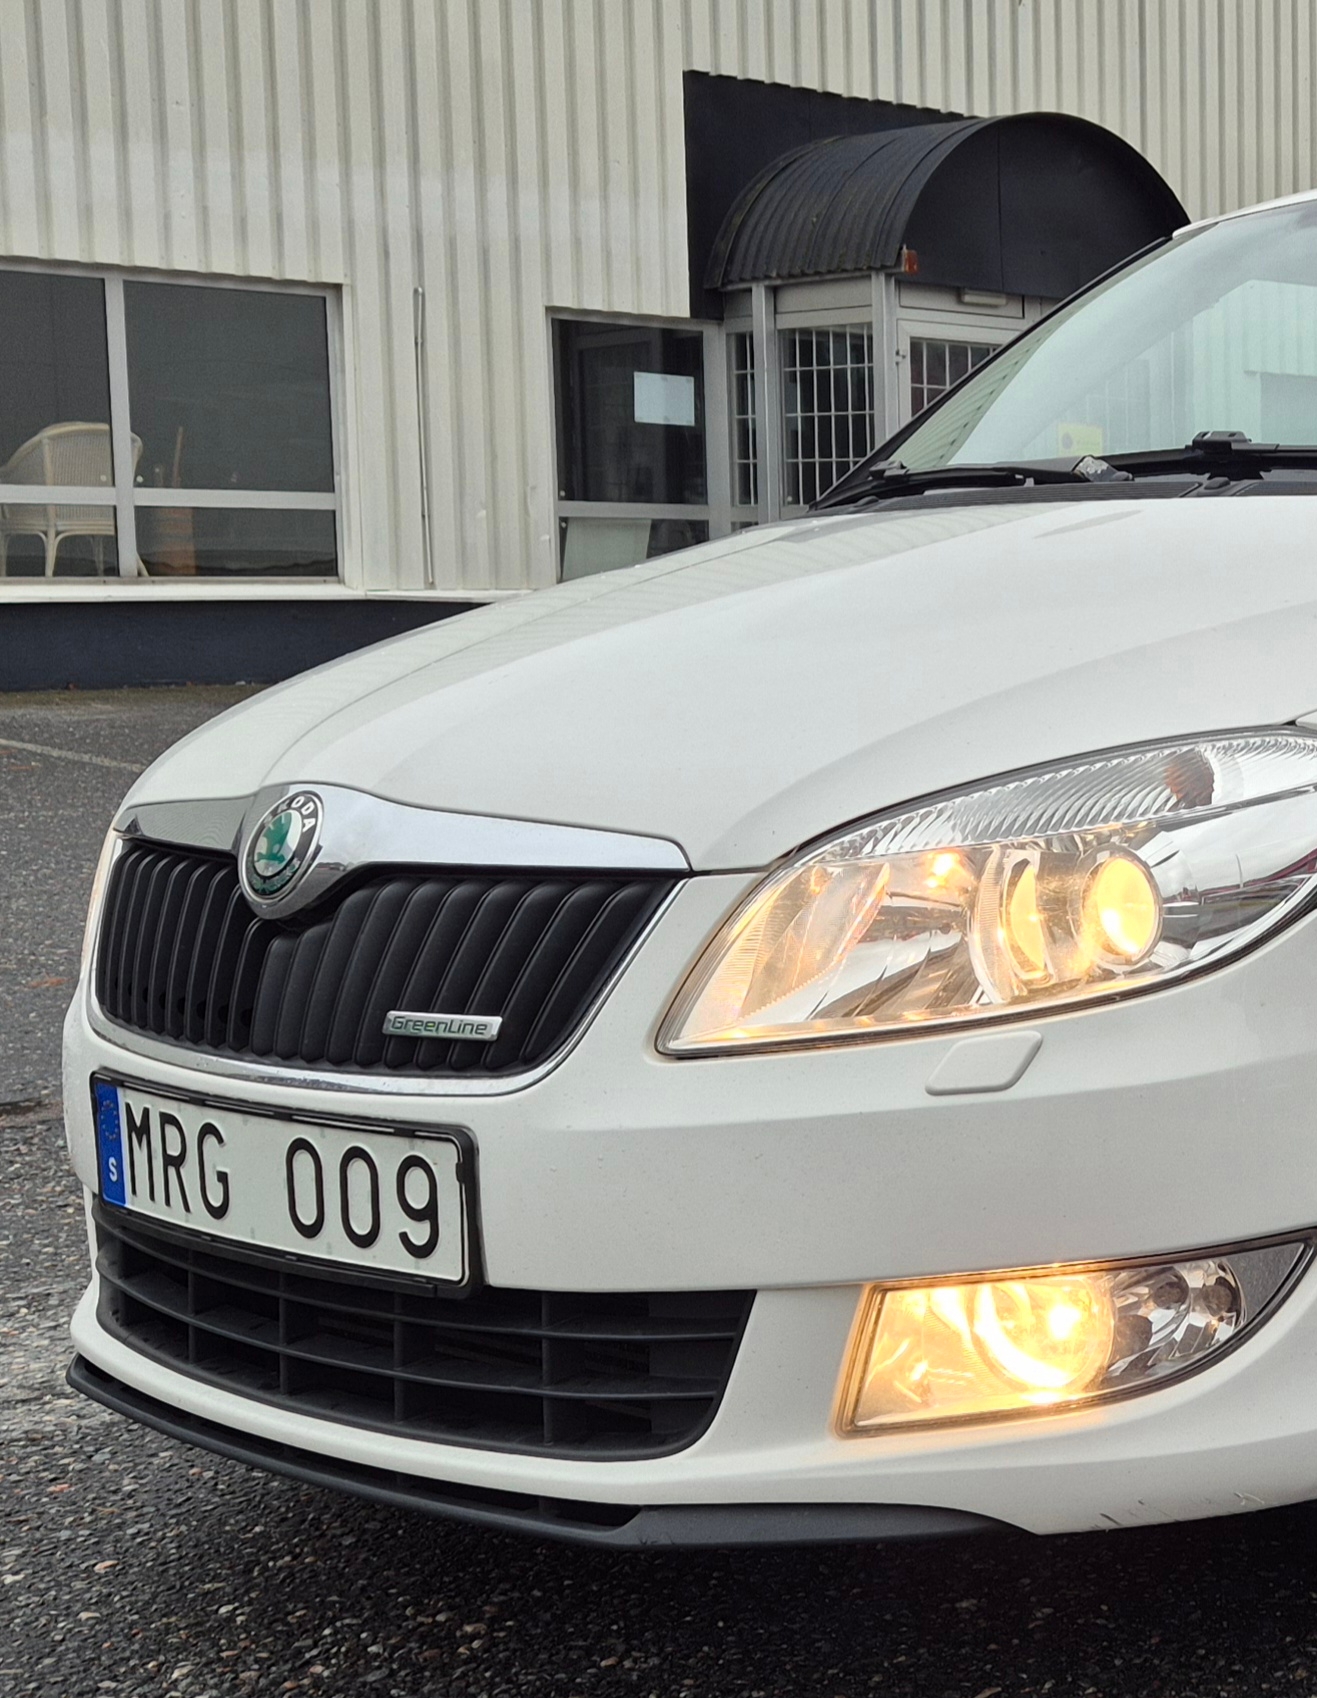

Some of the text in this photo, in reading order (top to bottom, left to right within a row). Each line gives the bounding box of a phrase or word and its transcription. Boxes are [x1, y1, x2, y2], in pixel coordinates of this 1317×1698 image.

[391, 1016, 488, 1035] GreenLine
[108, 1156, 118, 1182] S
[125, 1101, 439, 1259] MRG 009
